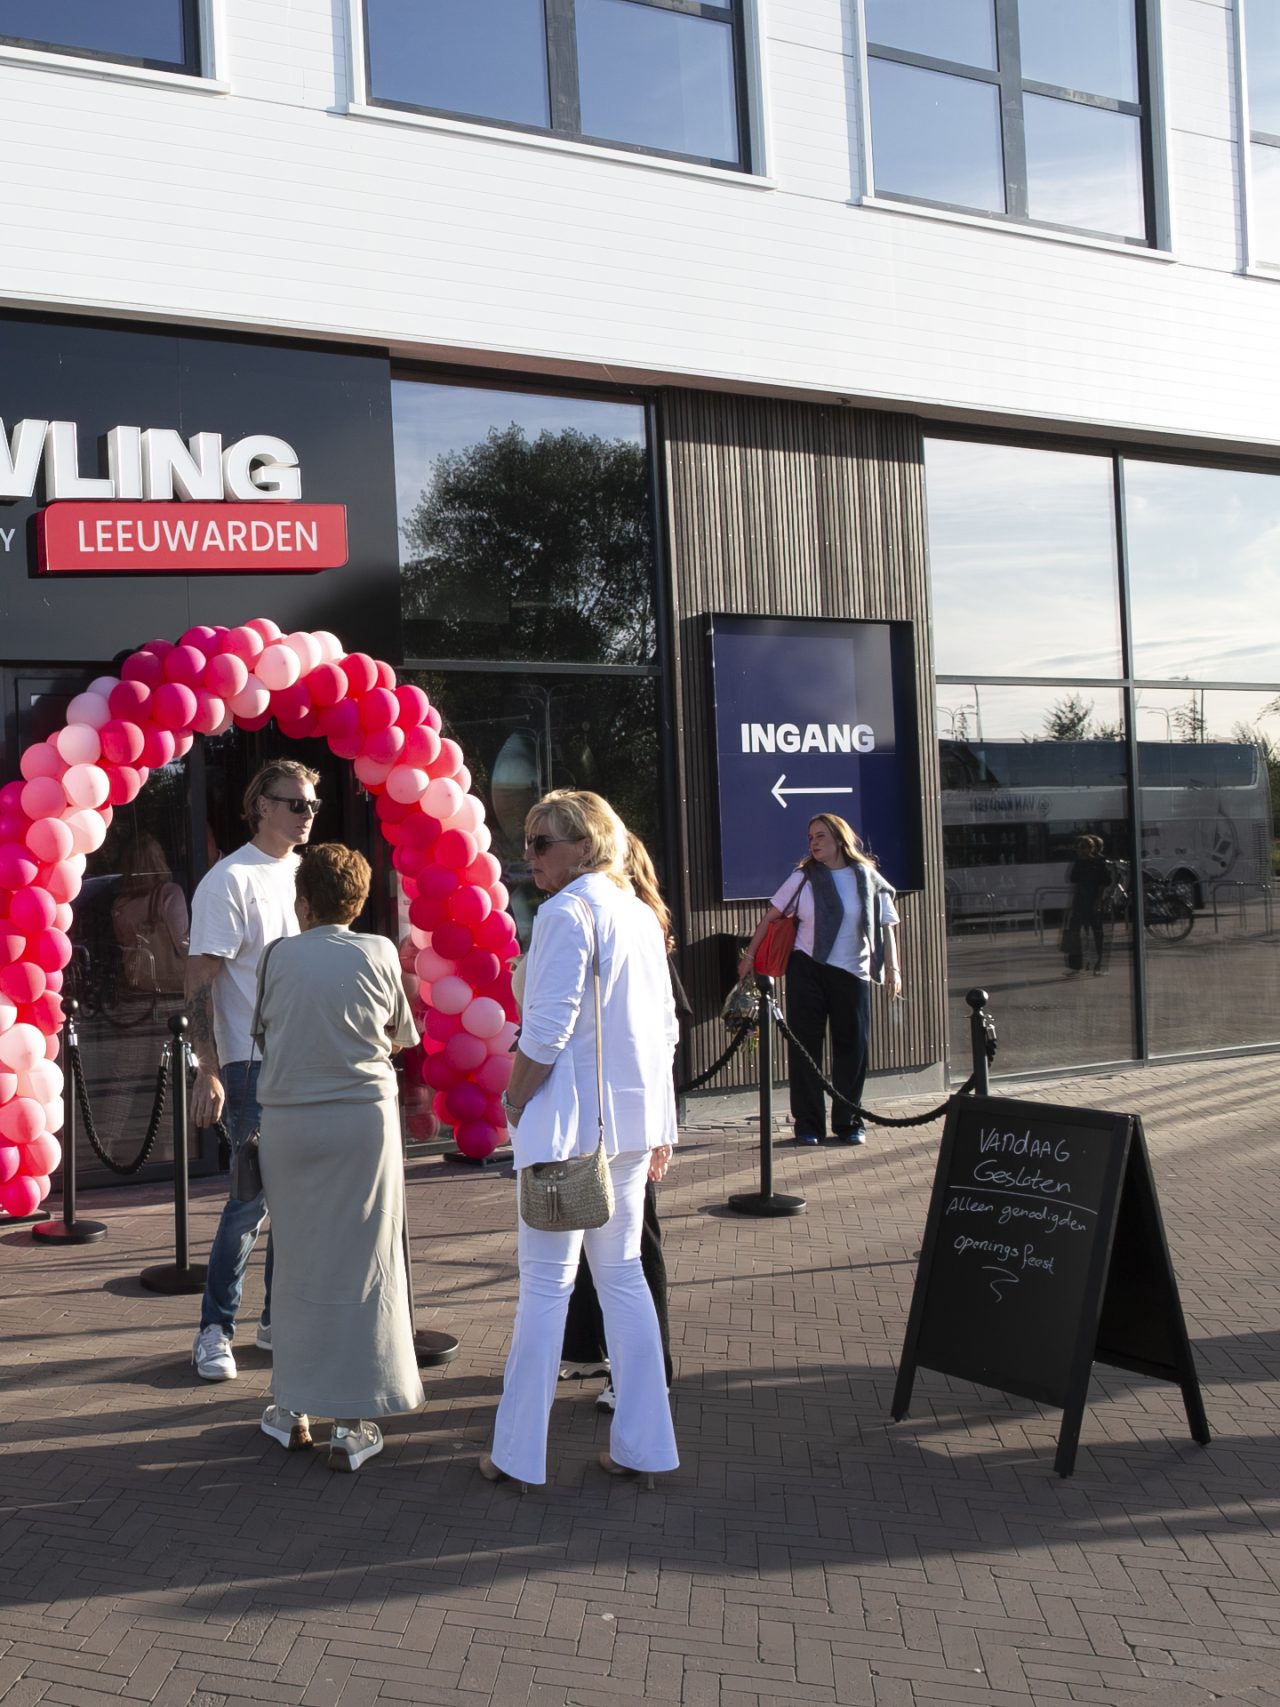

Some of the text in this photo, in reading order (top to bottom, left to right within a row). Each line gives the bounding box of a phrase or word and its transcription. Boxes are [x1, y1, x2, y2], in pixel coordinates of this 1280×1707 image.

[78, 519, 319, 553] LEEUWARDEN
[741, 723, 875, 753] INGANG
[973, 1159, 1071, 1193] Gesloten
[946, 1197, 994, 1215] Alleen
